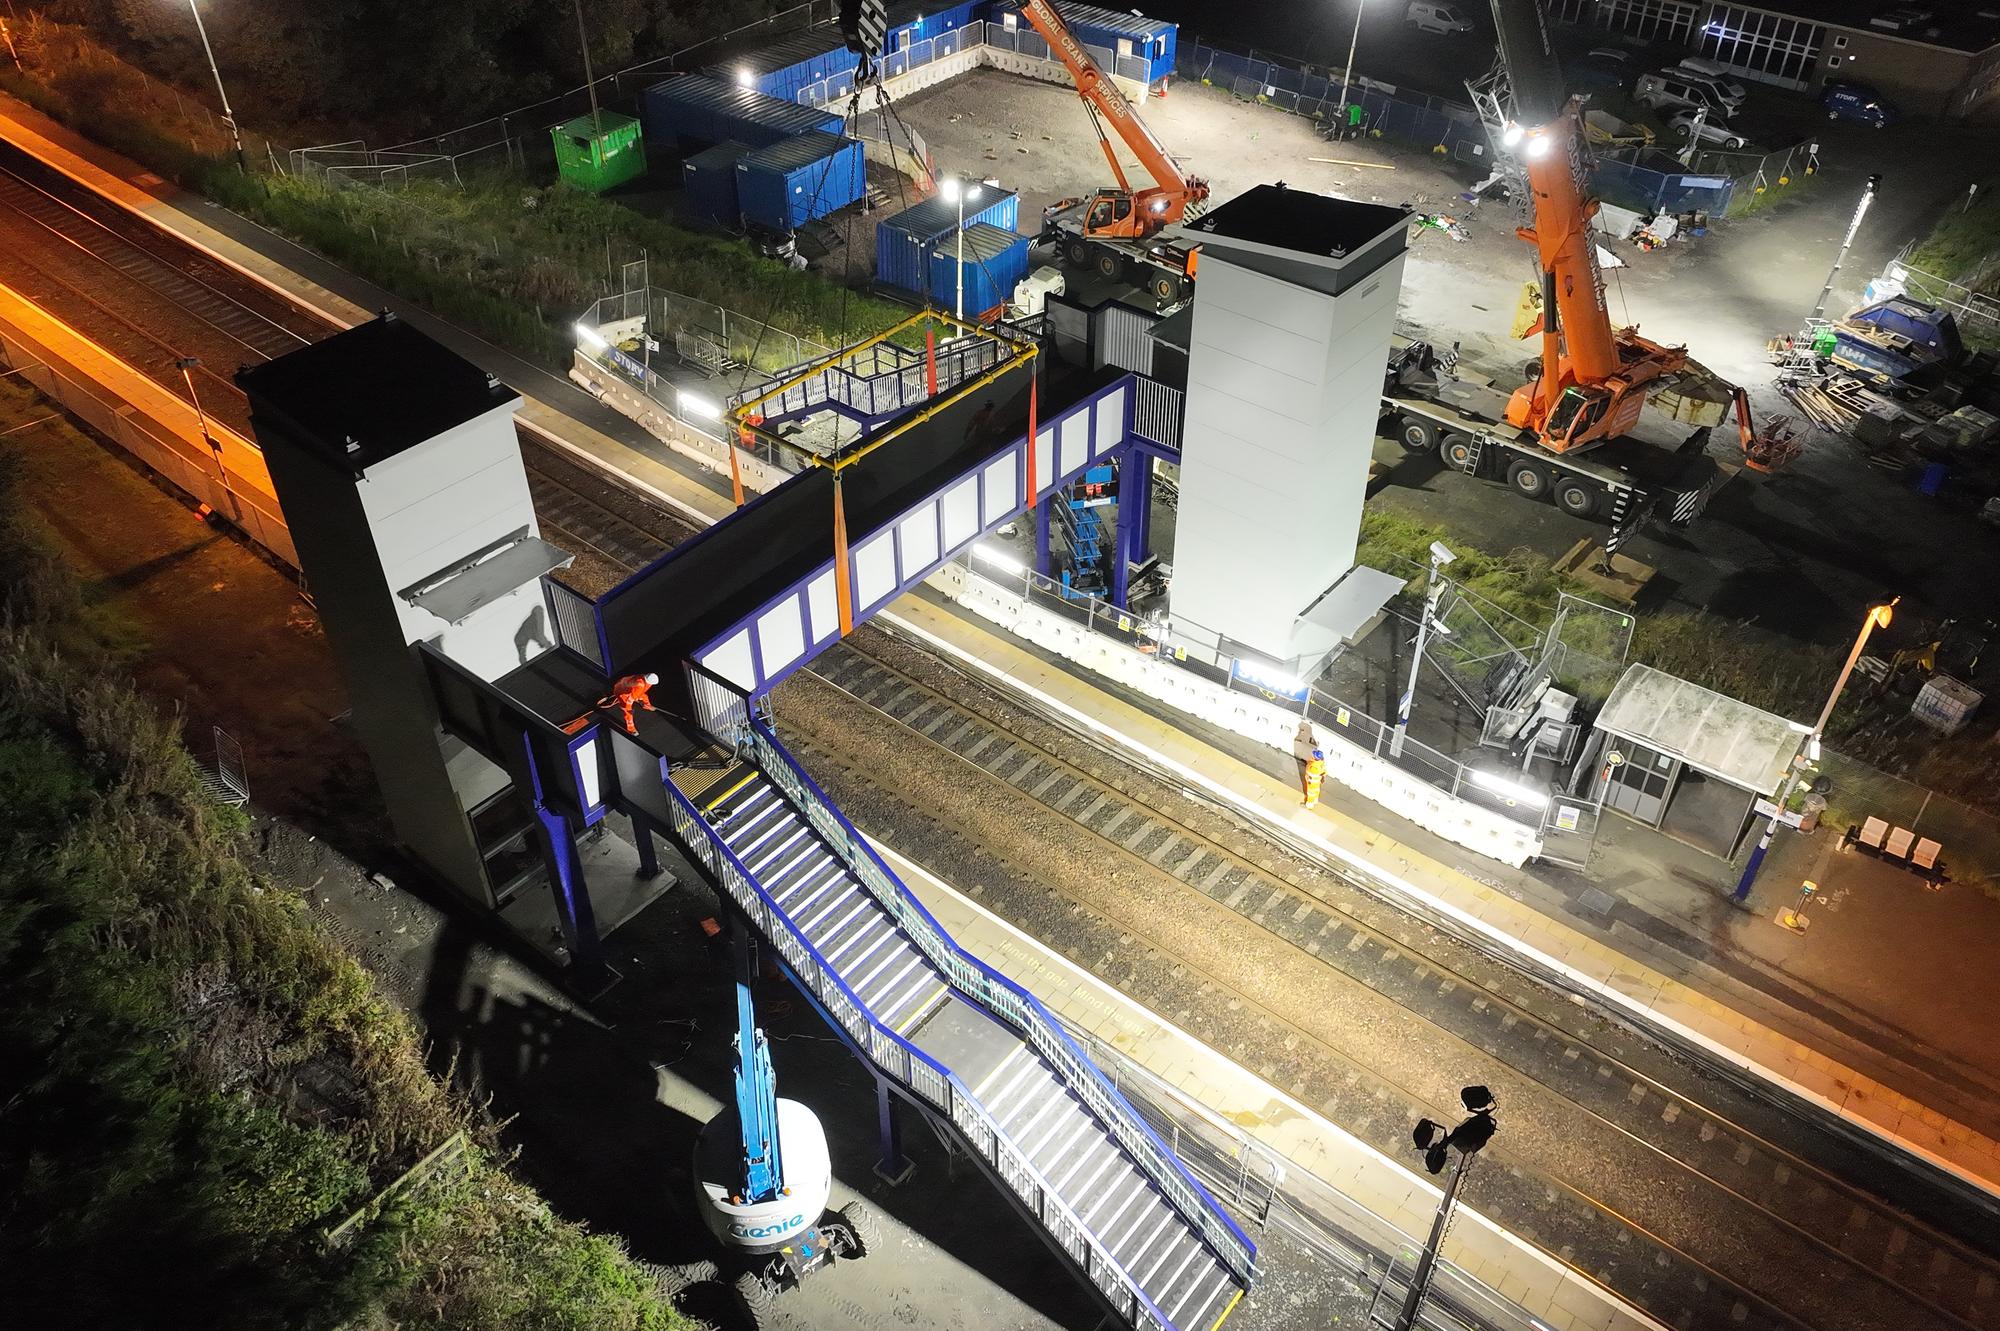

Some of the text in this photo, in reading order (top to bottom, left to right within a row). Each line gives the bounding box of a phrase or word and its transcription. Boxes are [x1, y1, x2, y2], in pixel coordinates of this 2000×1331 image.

[1032, 1, 1127, 119] GLOBAL CRANE SERVICES
[1835, 92, 1858, 102] STORY
[650, 341, 656, 350] 2
[614, 351, 644, 379] STORY
